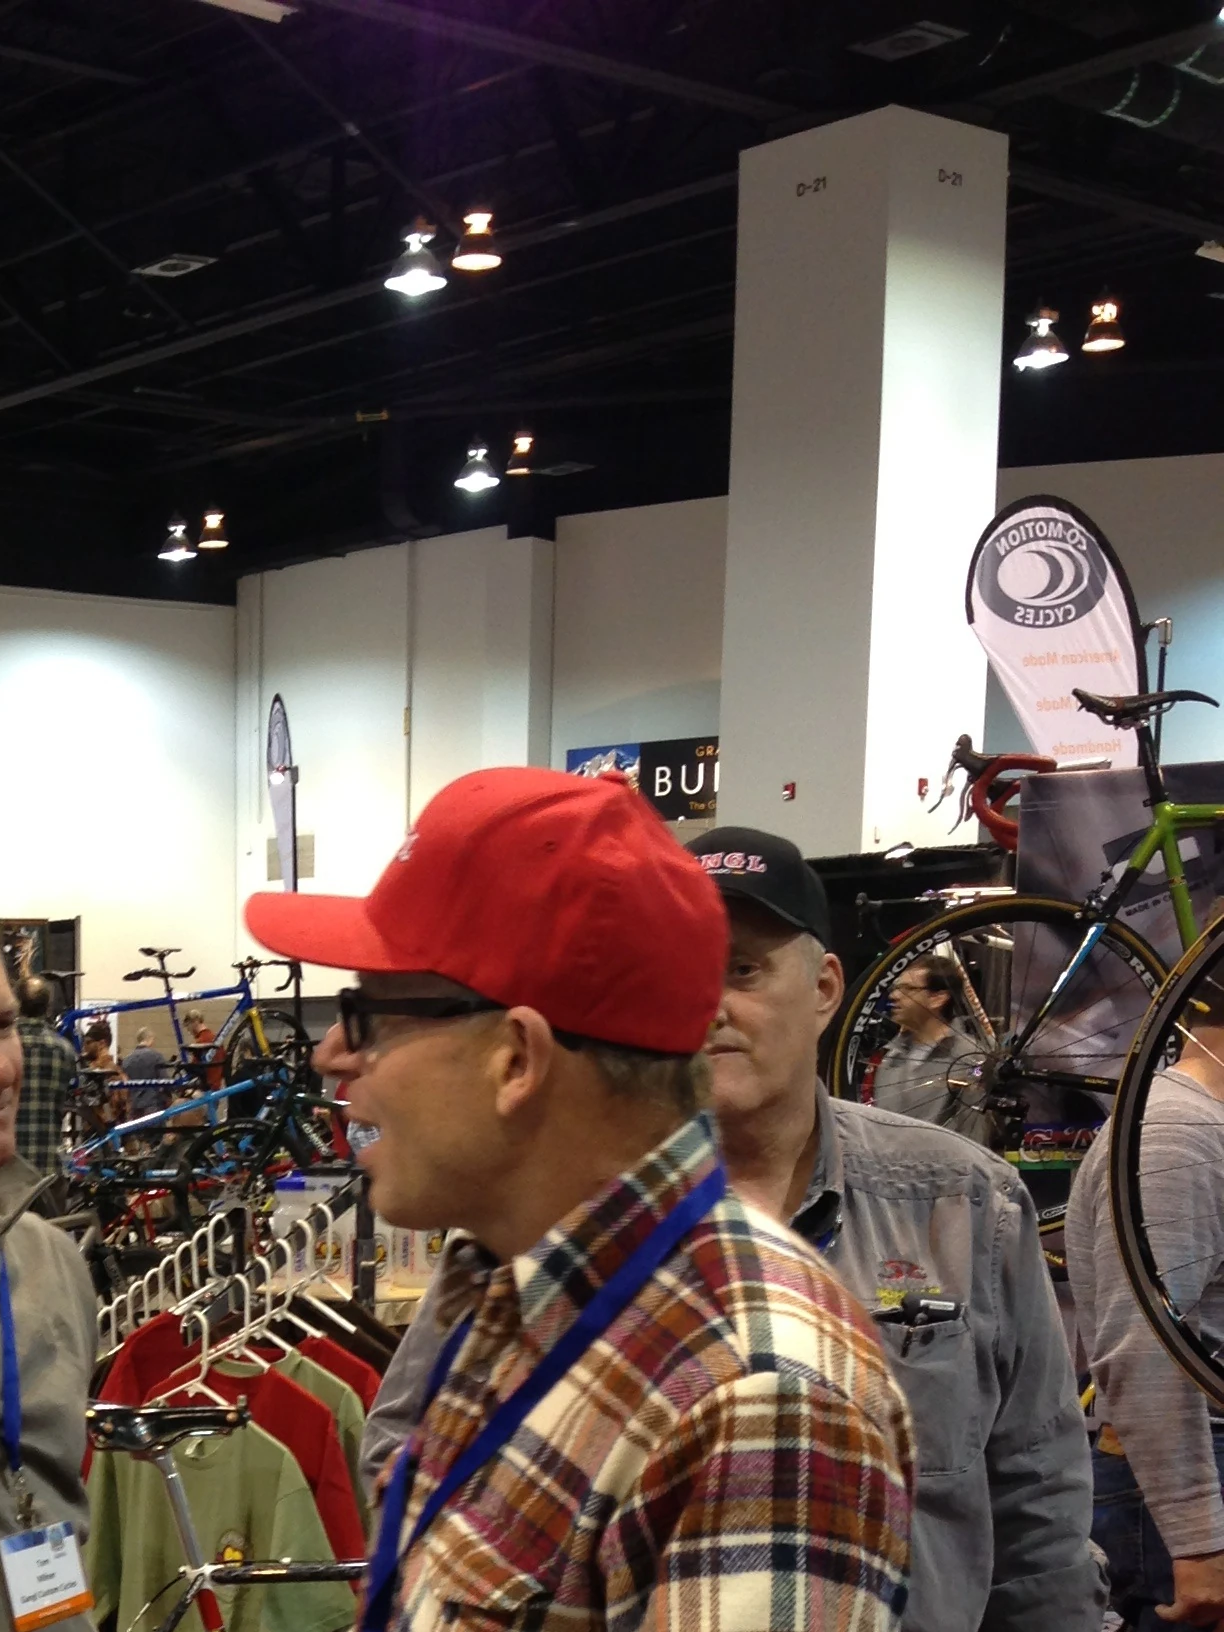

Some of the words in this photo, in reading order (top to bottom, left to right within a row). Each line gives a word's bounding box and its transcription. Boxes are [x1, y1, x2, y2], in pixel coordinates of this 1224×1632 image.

[796, 176, 827, 197] D-21
[937, 168, 963, 187] D-21
[853, 928, 952, 1034] REYNOLDS
